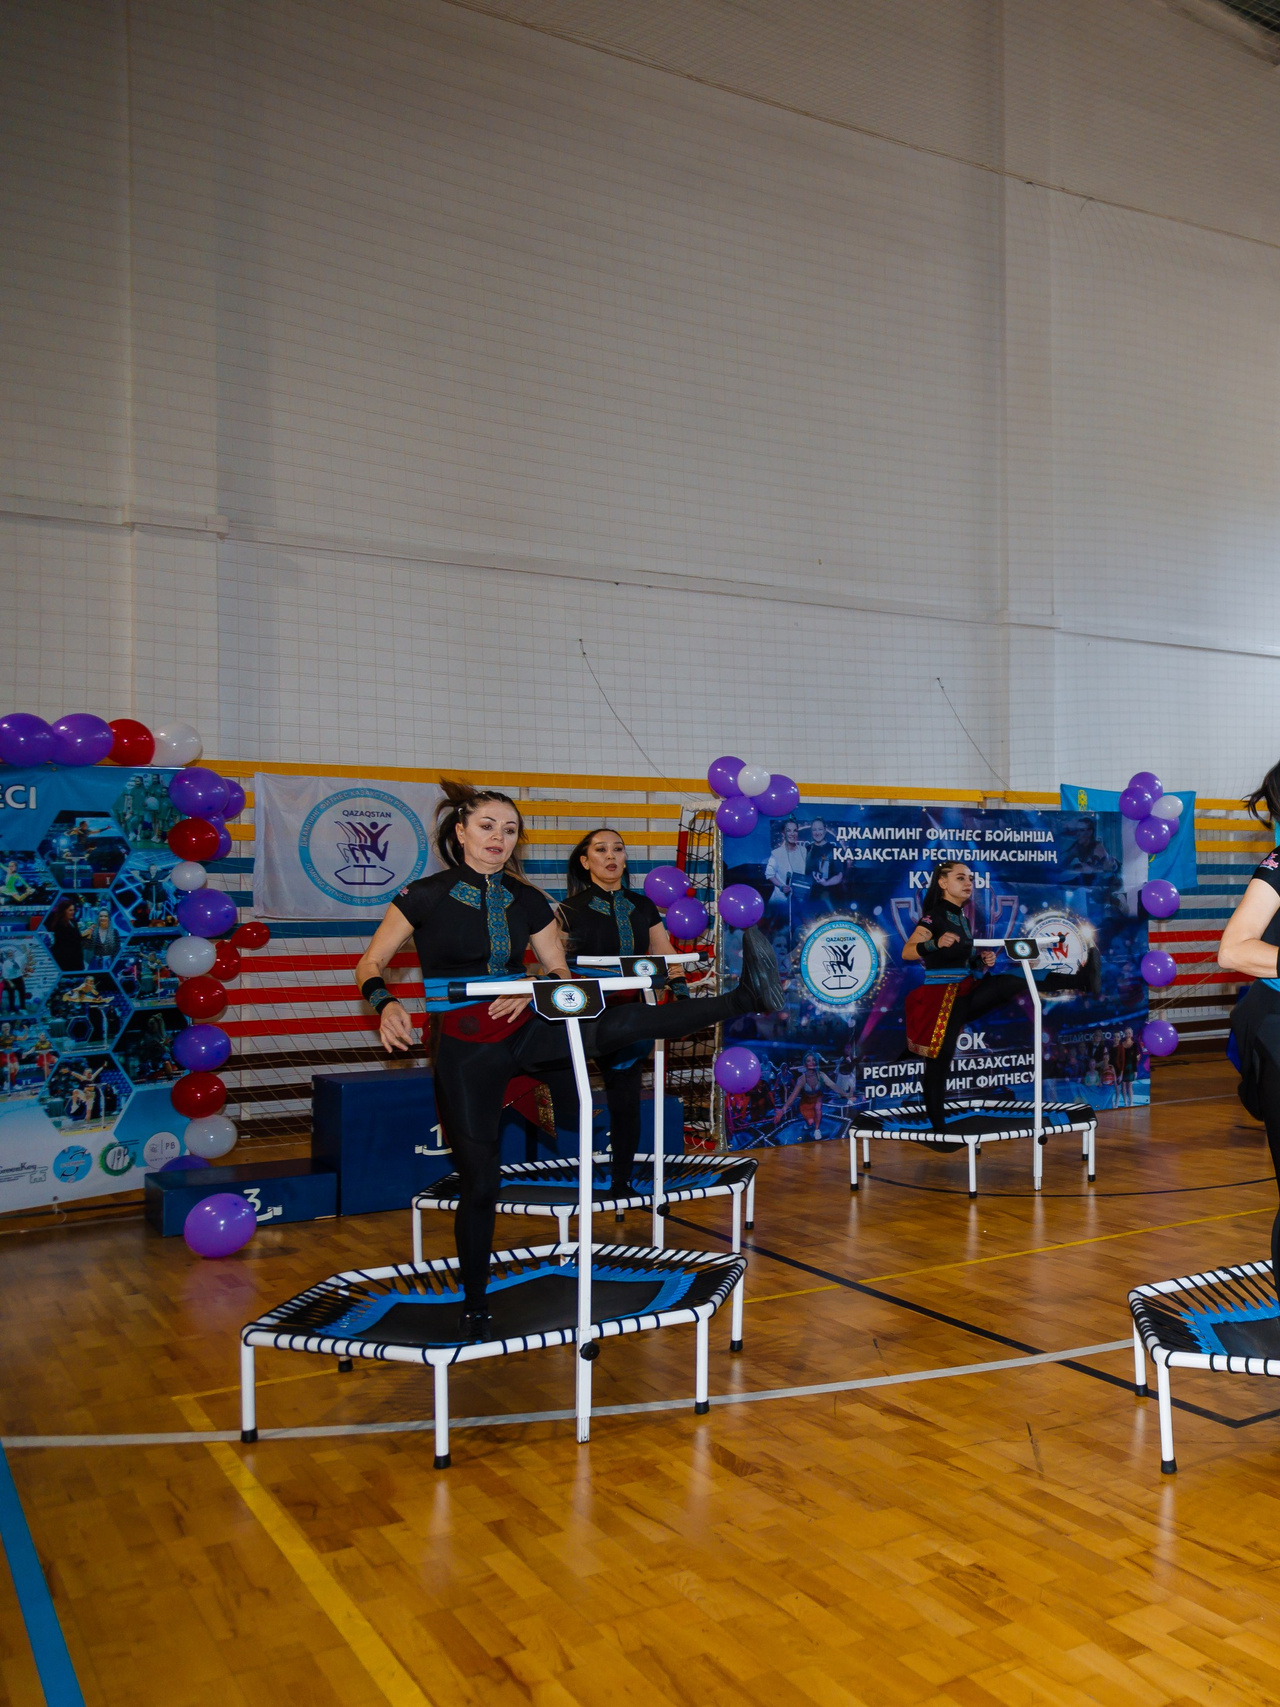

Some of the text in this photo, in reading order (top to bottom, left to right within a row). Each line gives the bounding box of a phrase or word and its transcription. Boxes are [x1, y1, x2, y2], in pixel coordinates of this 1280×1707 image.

[342, 809, 391, 818] QAZAQSTAN
[836, 827, 1054, 843] ДЖАМПИНГ ФИТНЕС БОЙЫНША
[833, 848, 1058, 864] ҚАЗАҚСТАН РЕСПУБЛИКАСЫНЫҢ
[326, 884, 351, 902] FITNESS
[353, 895, 387, 904] REPUBLIC
[958, 1053, 1035, 1072] КАЗАХСТАН
[865, 1085, 888, 1099] ПО
[890, 1077, 973, 1099] ДЖАИНГ
[430, 1123, 442, 1147] 1
[165, 1141, 175, 1150] PB
[243, 1188, 261, 1212] 3
